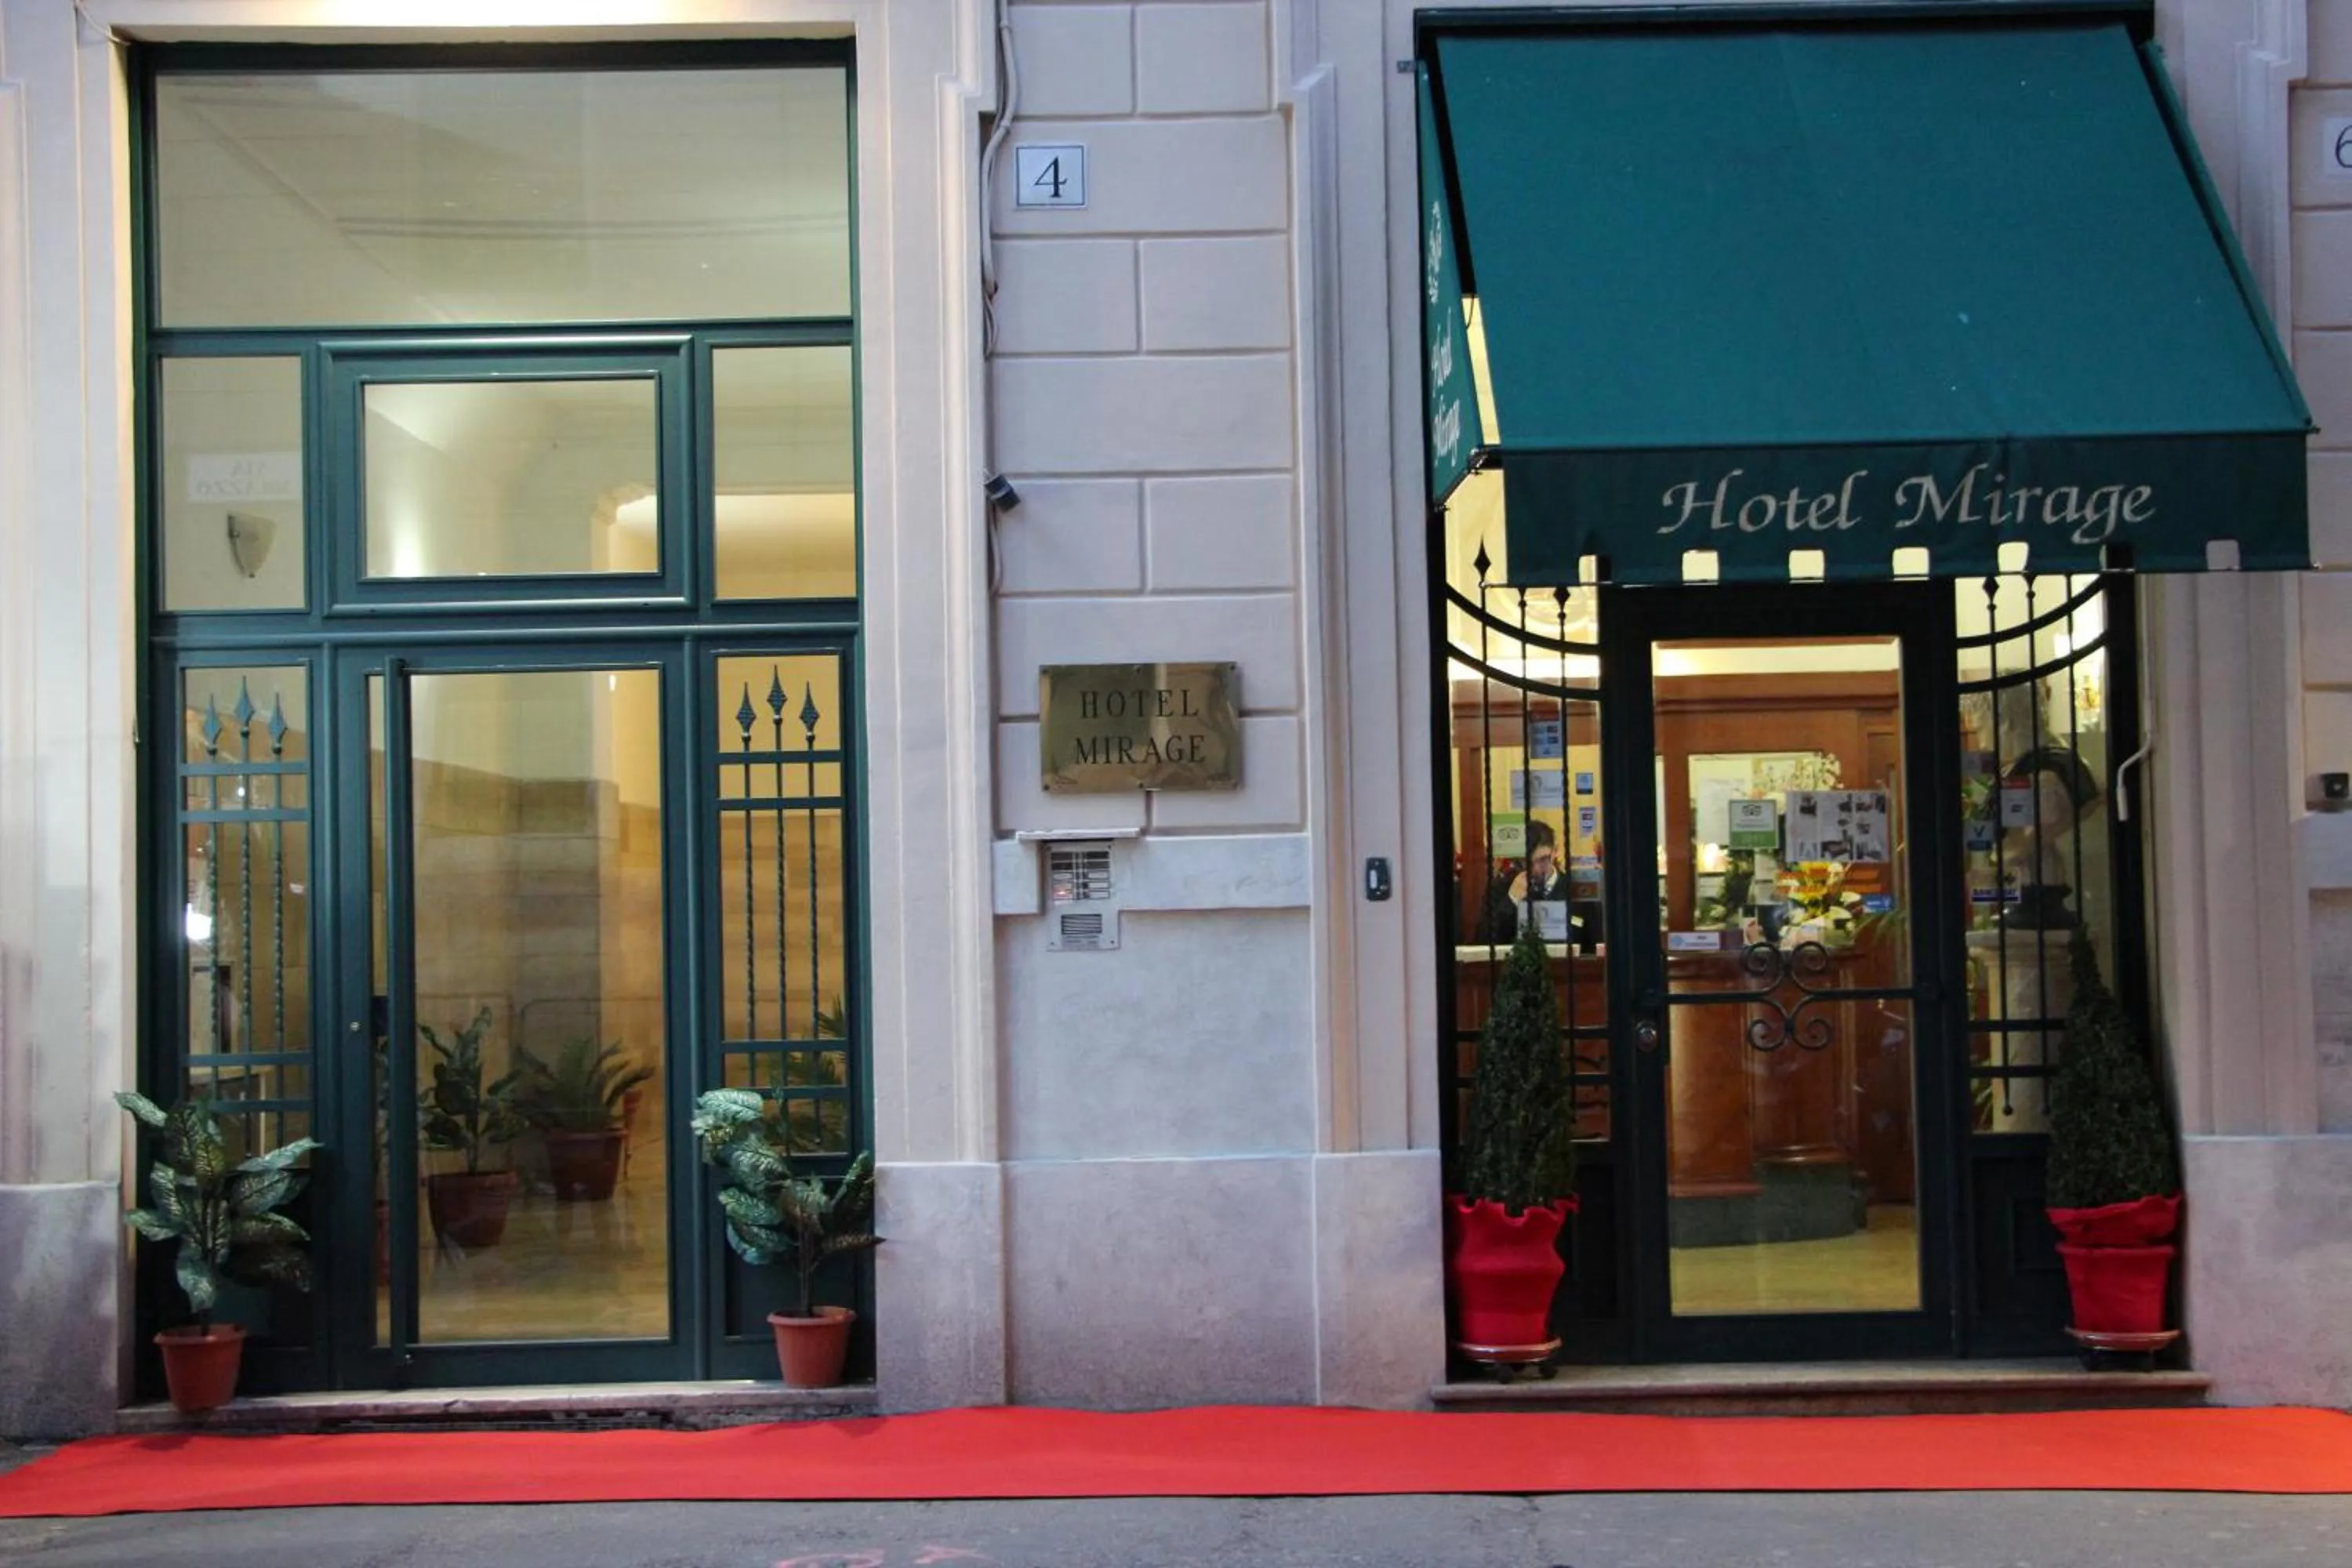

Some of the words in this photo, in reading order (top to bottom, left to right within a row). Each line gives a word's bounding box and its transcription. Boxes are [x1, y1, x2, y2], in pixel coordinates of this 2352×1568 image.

[1034, 155, 1068, 198] 4
[1656, 469, 1868, 535] Hotel
[1893, 463, 2157, 545] Mirage
[1080, 688, 1200, 720] HOTEL
[1074, 733, 1206, 765] MIRAGE
